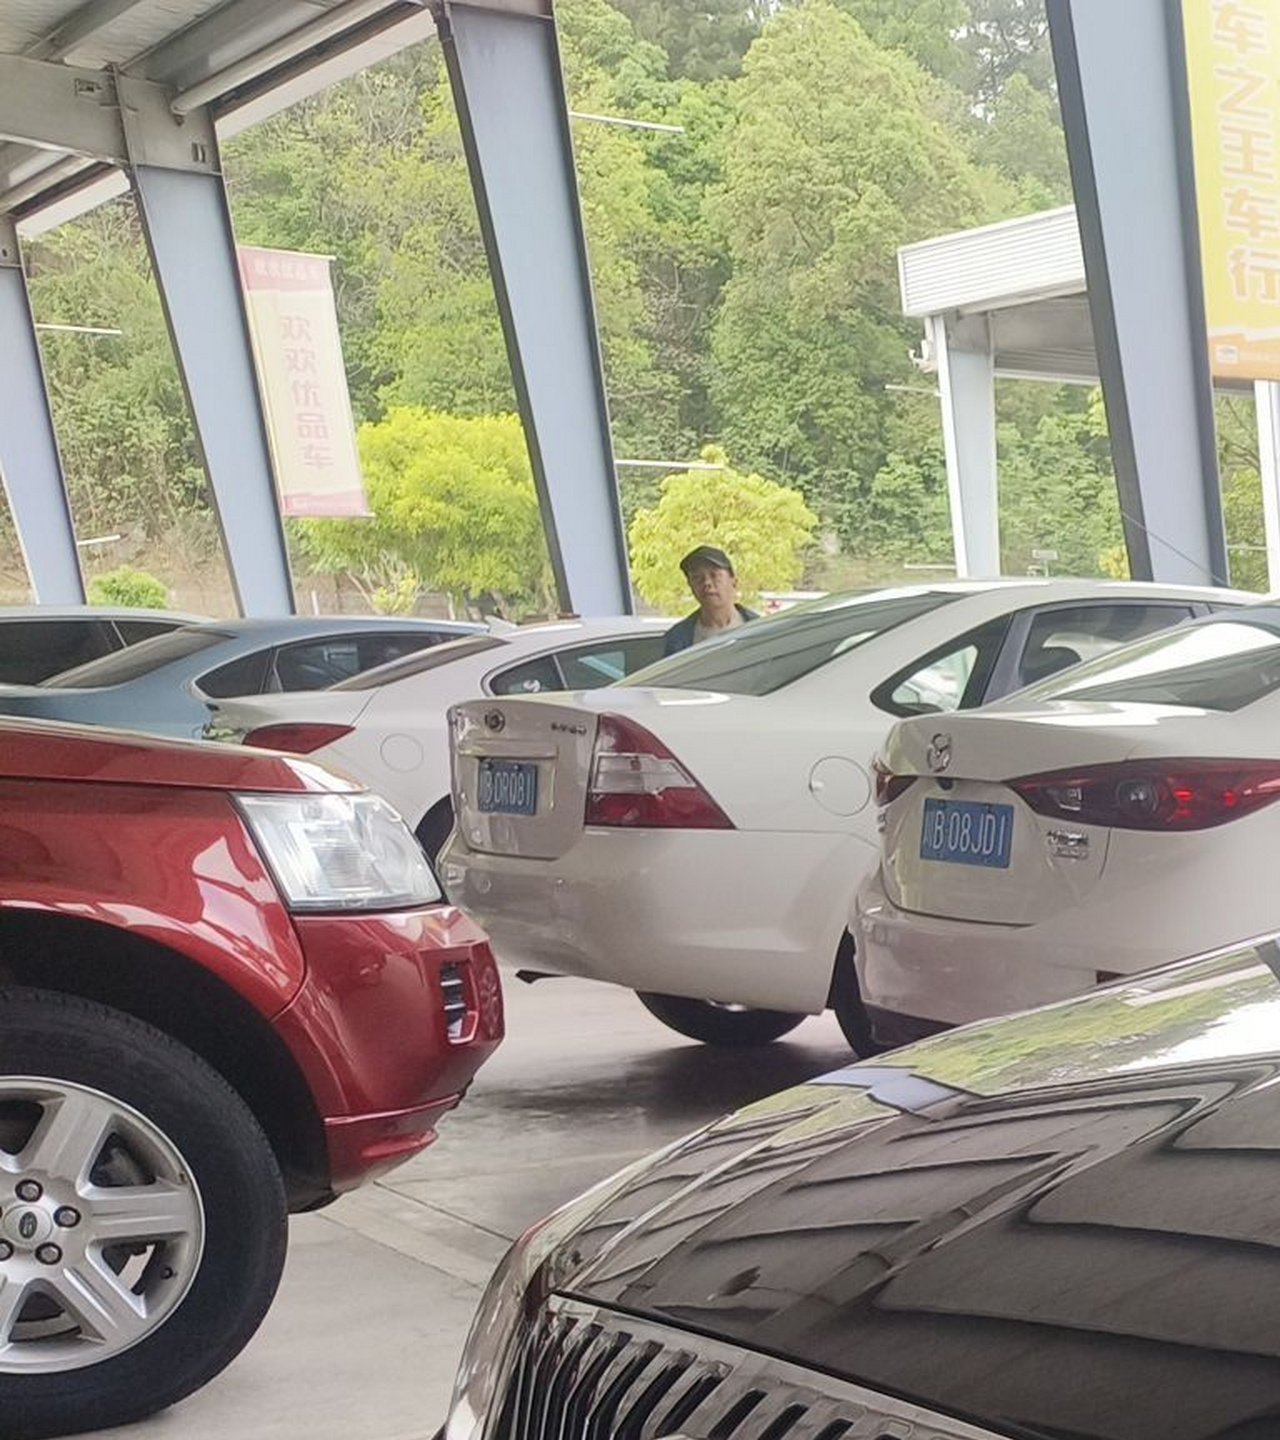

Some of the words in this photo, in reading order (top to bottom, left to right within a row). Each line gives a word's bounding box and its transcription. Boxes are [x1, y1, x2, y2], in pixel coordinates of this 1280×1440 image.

[280, 317, 334, 470] 欢欢优品车
